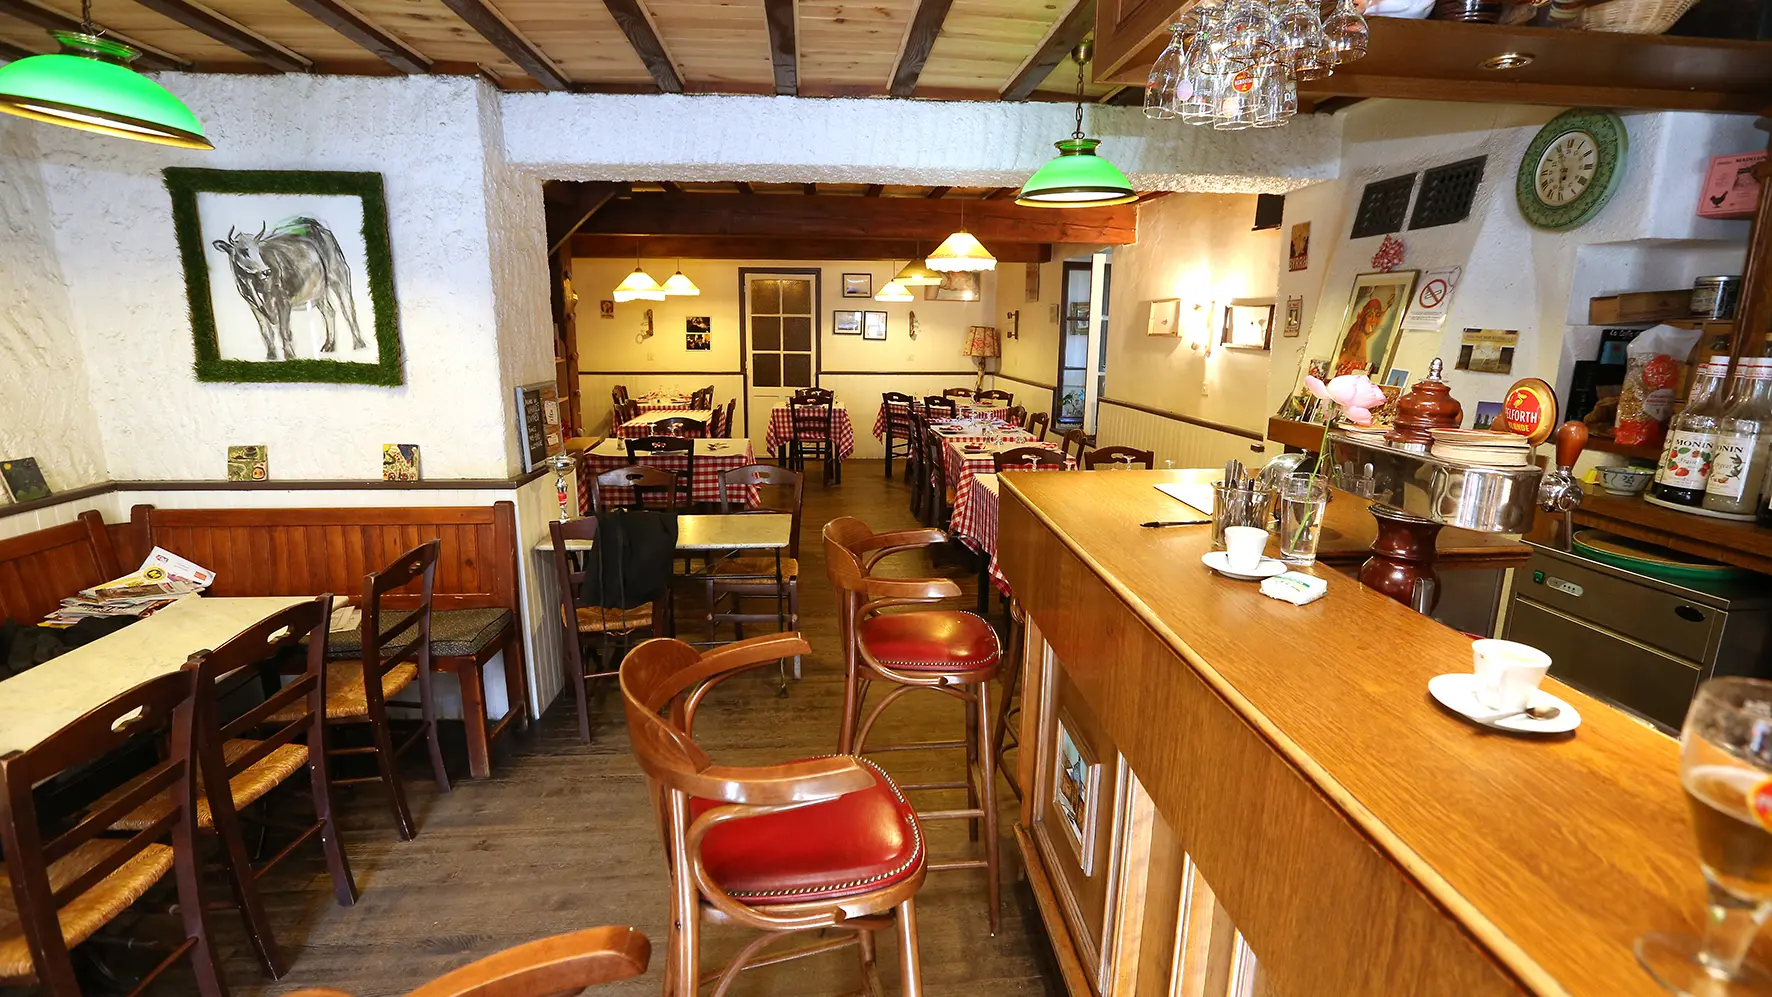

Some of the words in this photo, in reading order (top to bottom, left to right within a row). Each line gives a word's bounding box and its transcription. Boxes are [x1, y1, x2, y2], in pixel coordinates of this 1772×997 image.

[1506, 408, 1538, 424] ELFORTH
[1676, 438, 1714, 449] MONIN
[1718, 445, 1744, 453] NIN
